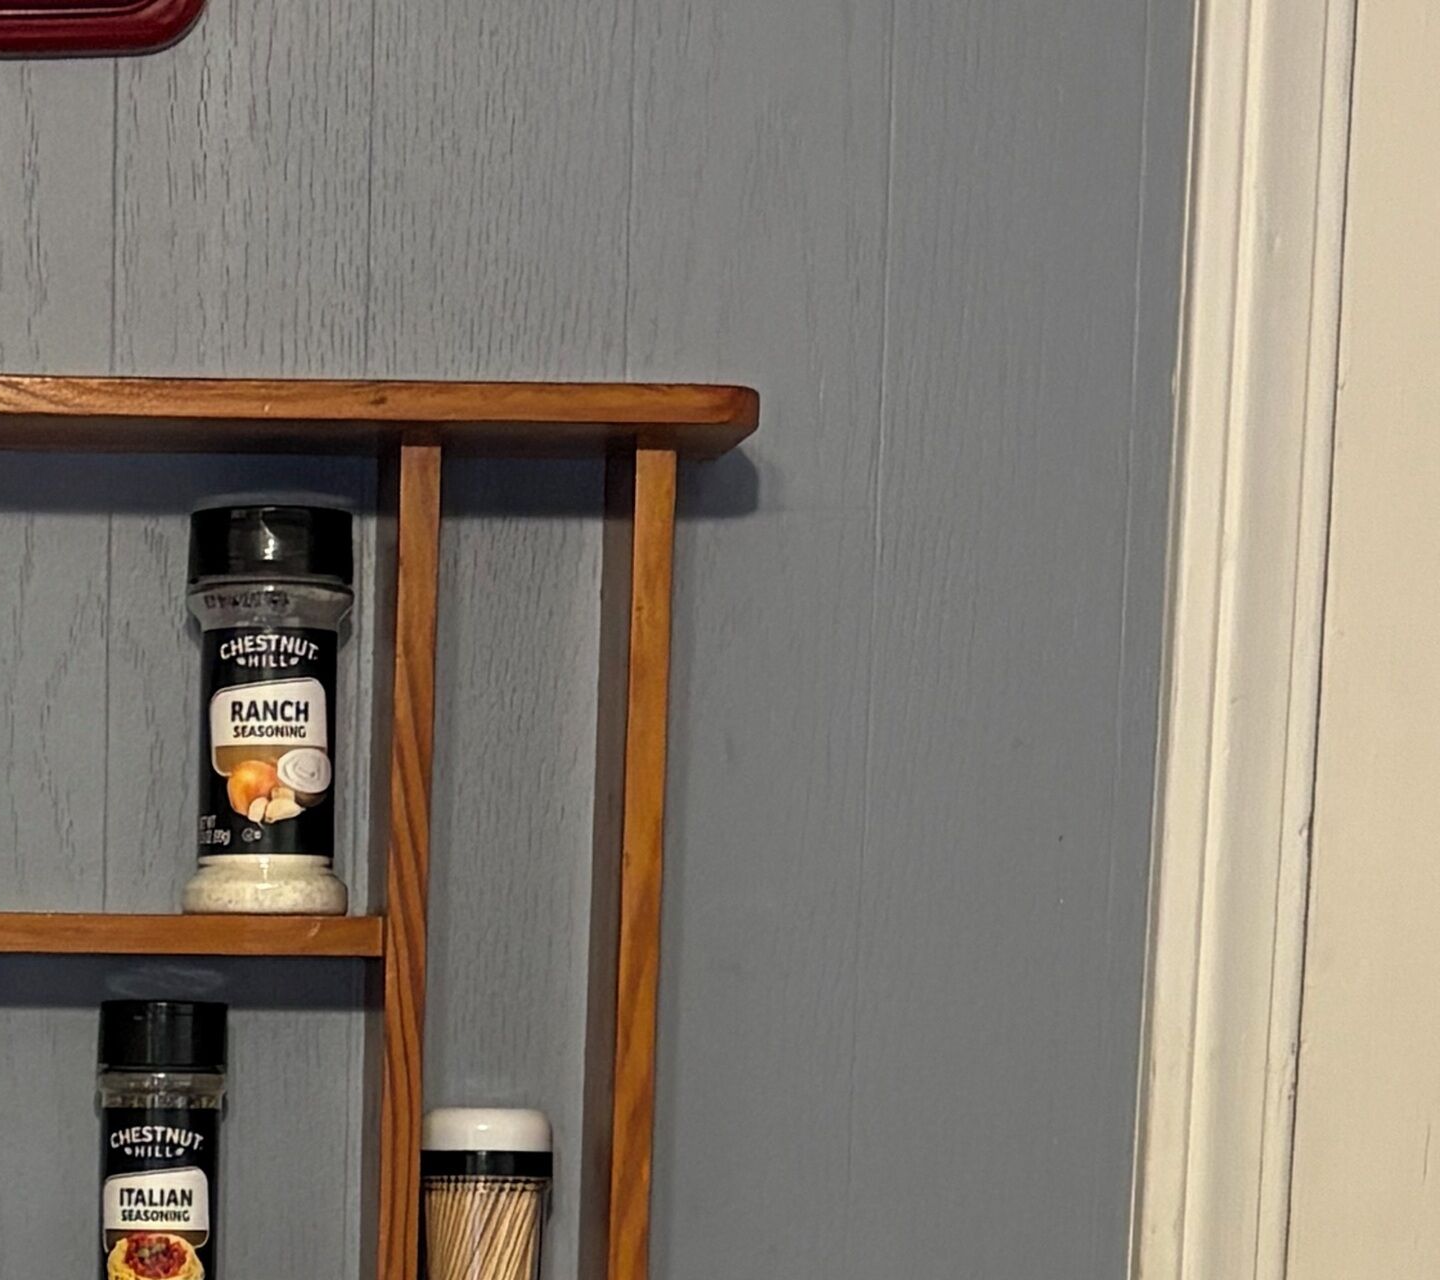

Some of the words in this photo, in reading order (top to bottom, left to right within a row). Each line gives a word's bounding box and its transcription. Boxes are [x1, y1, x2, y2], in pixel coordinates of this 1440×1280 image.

[220, 634, 319, 660] CHESTNUT
[248, 656, 287, 668] HILL
[231, 700, 309, 723] RANCH
[233, 725, 307, 739] SEASONING
[110, 1126, 204, 1150] CHESTNUT
[135, 1146, 173, 1158] HILL
[119, 1188, 193, 1207] ITALIAN
[121, 1208, 191, 1222] SEASONING
